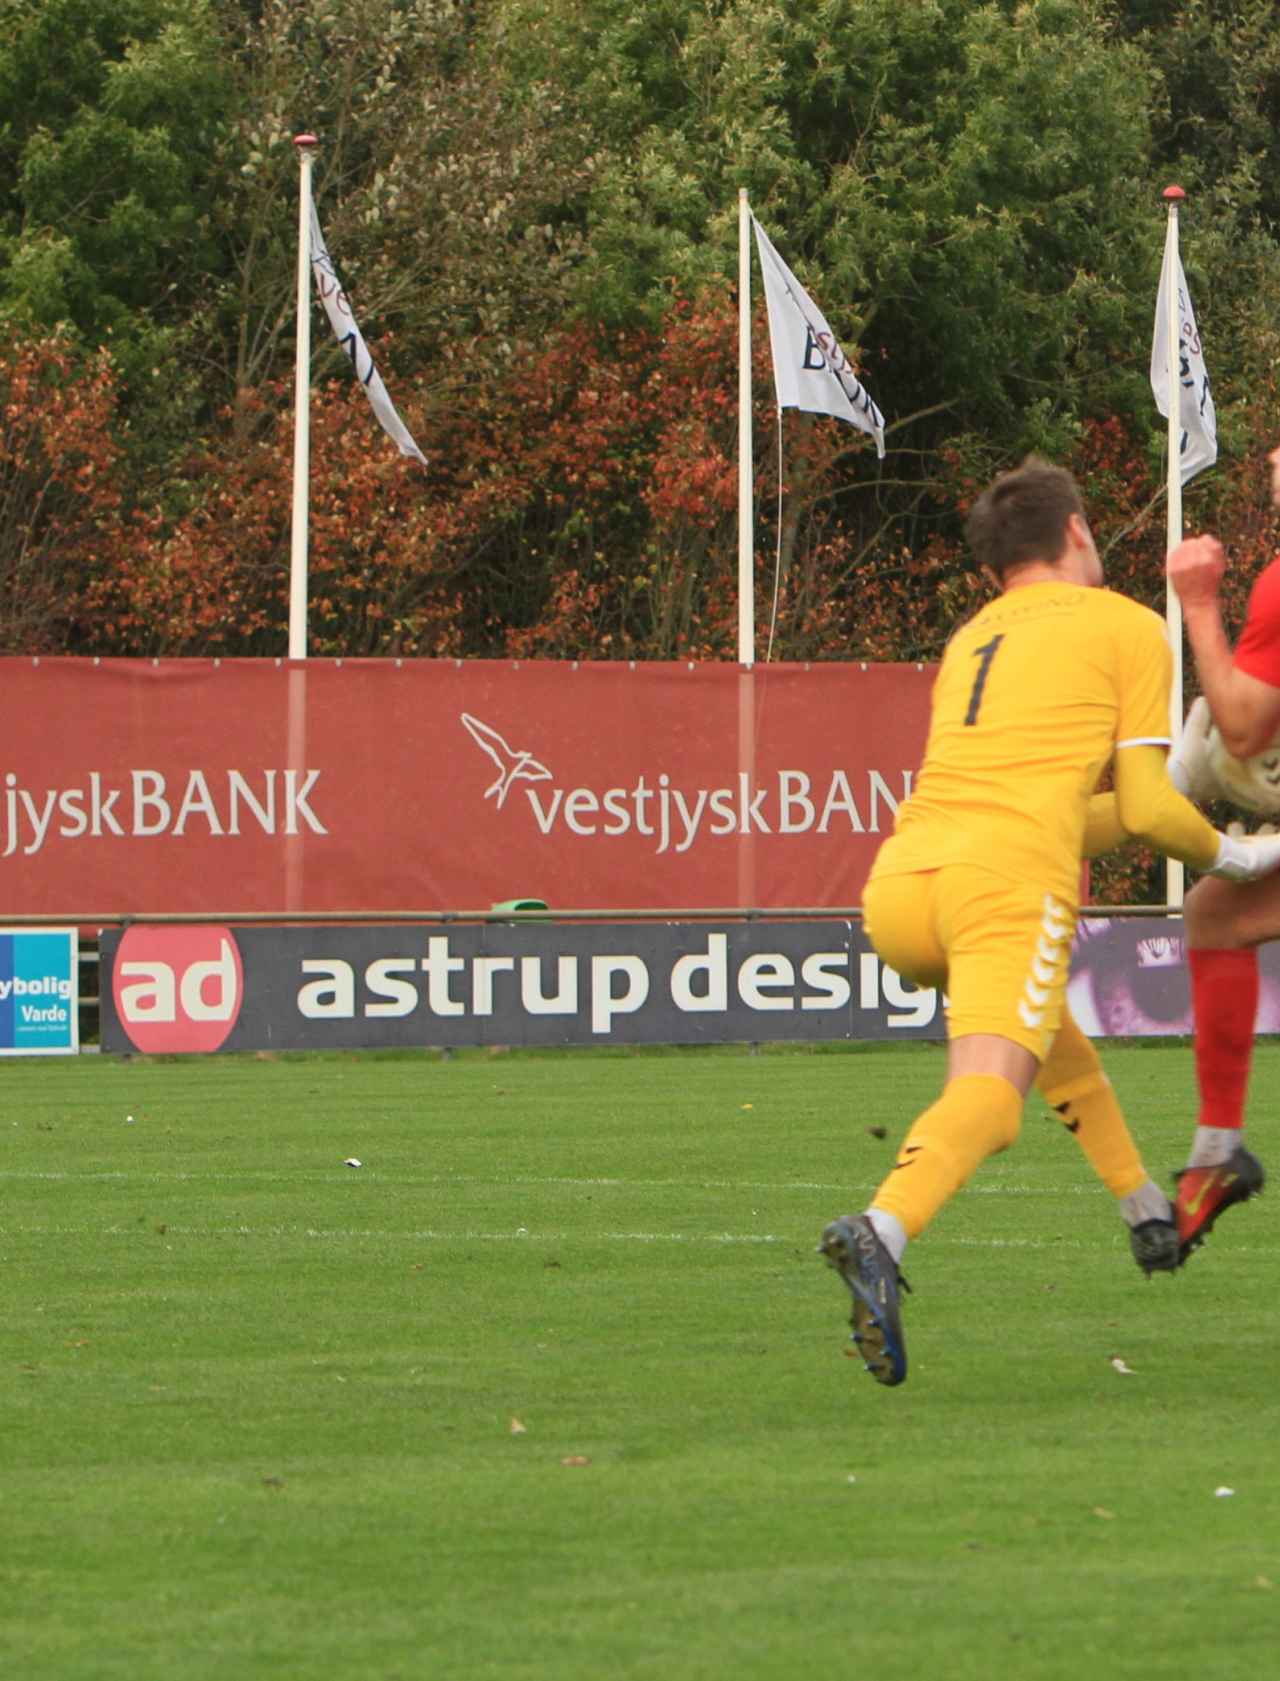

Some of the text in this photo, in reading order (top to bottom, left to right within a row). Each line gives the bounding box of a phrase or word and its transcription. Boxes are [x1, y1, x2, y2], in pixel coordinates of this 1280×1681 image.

[964, 633, 1005, 727] 1
[2, 769, 328, 857] jyskBANK
[525, 769, 913, 855] vestjyskBAN
[21, 1004, 67, 1022] Varde
[119, 938, 237, 1023] ad
[297, 933, 951, 1034] astrup desig
